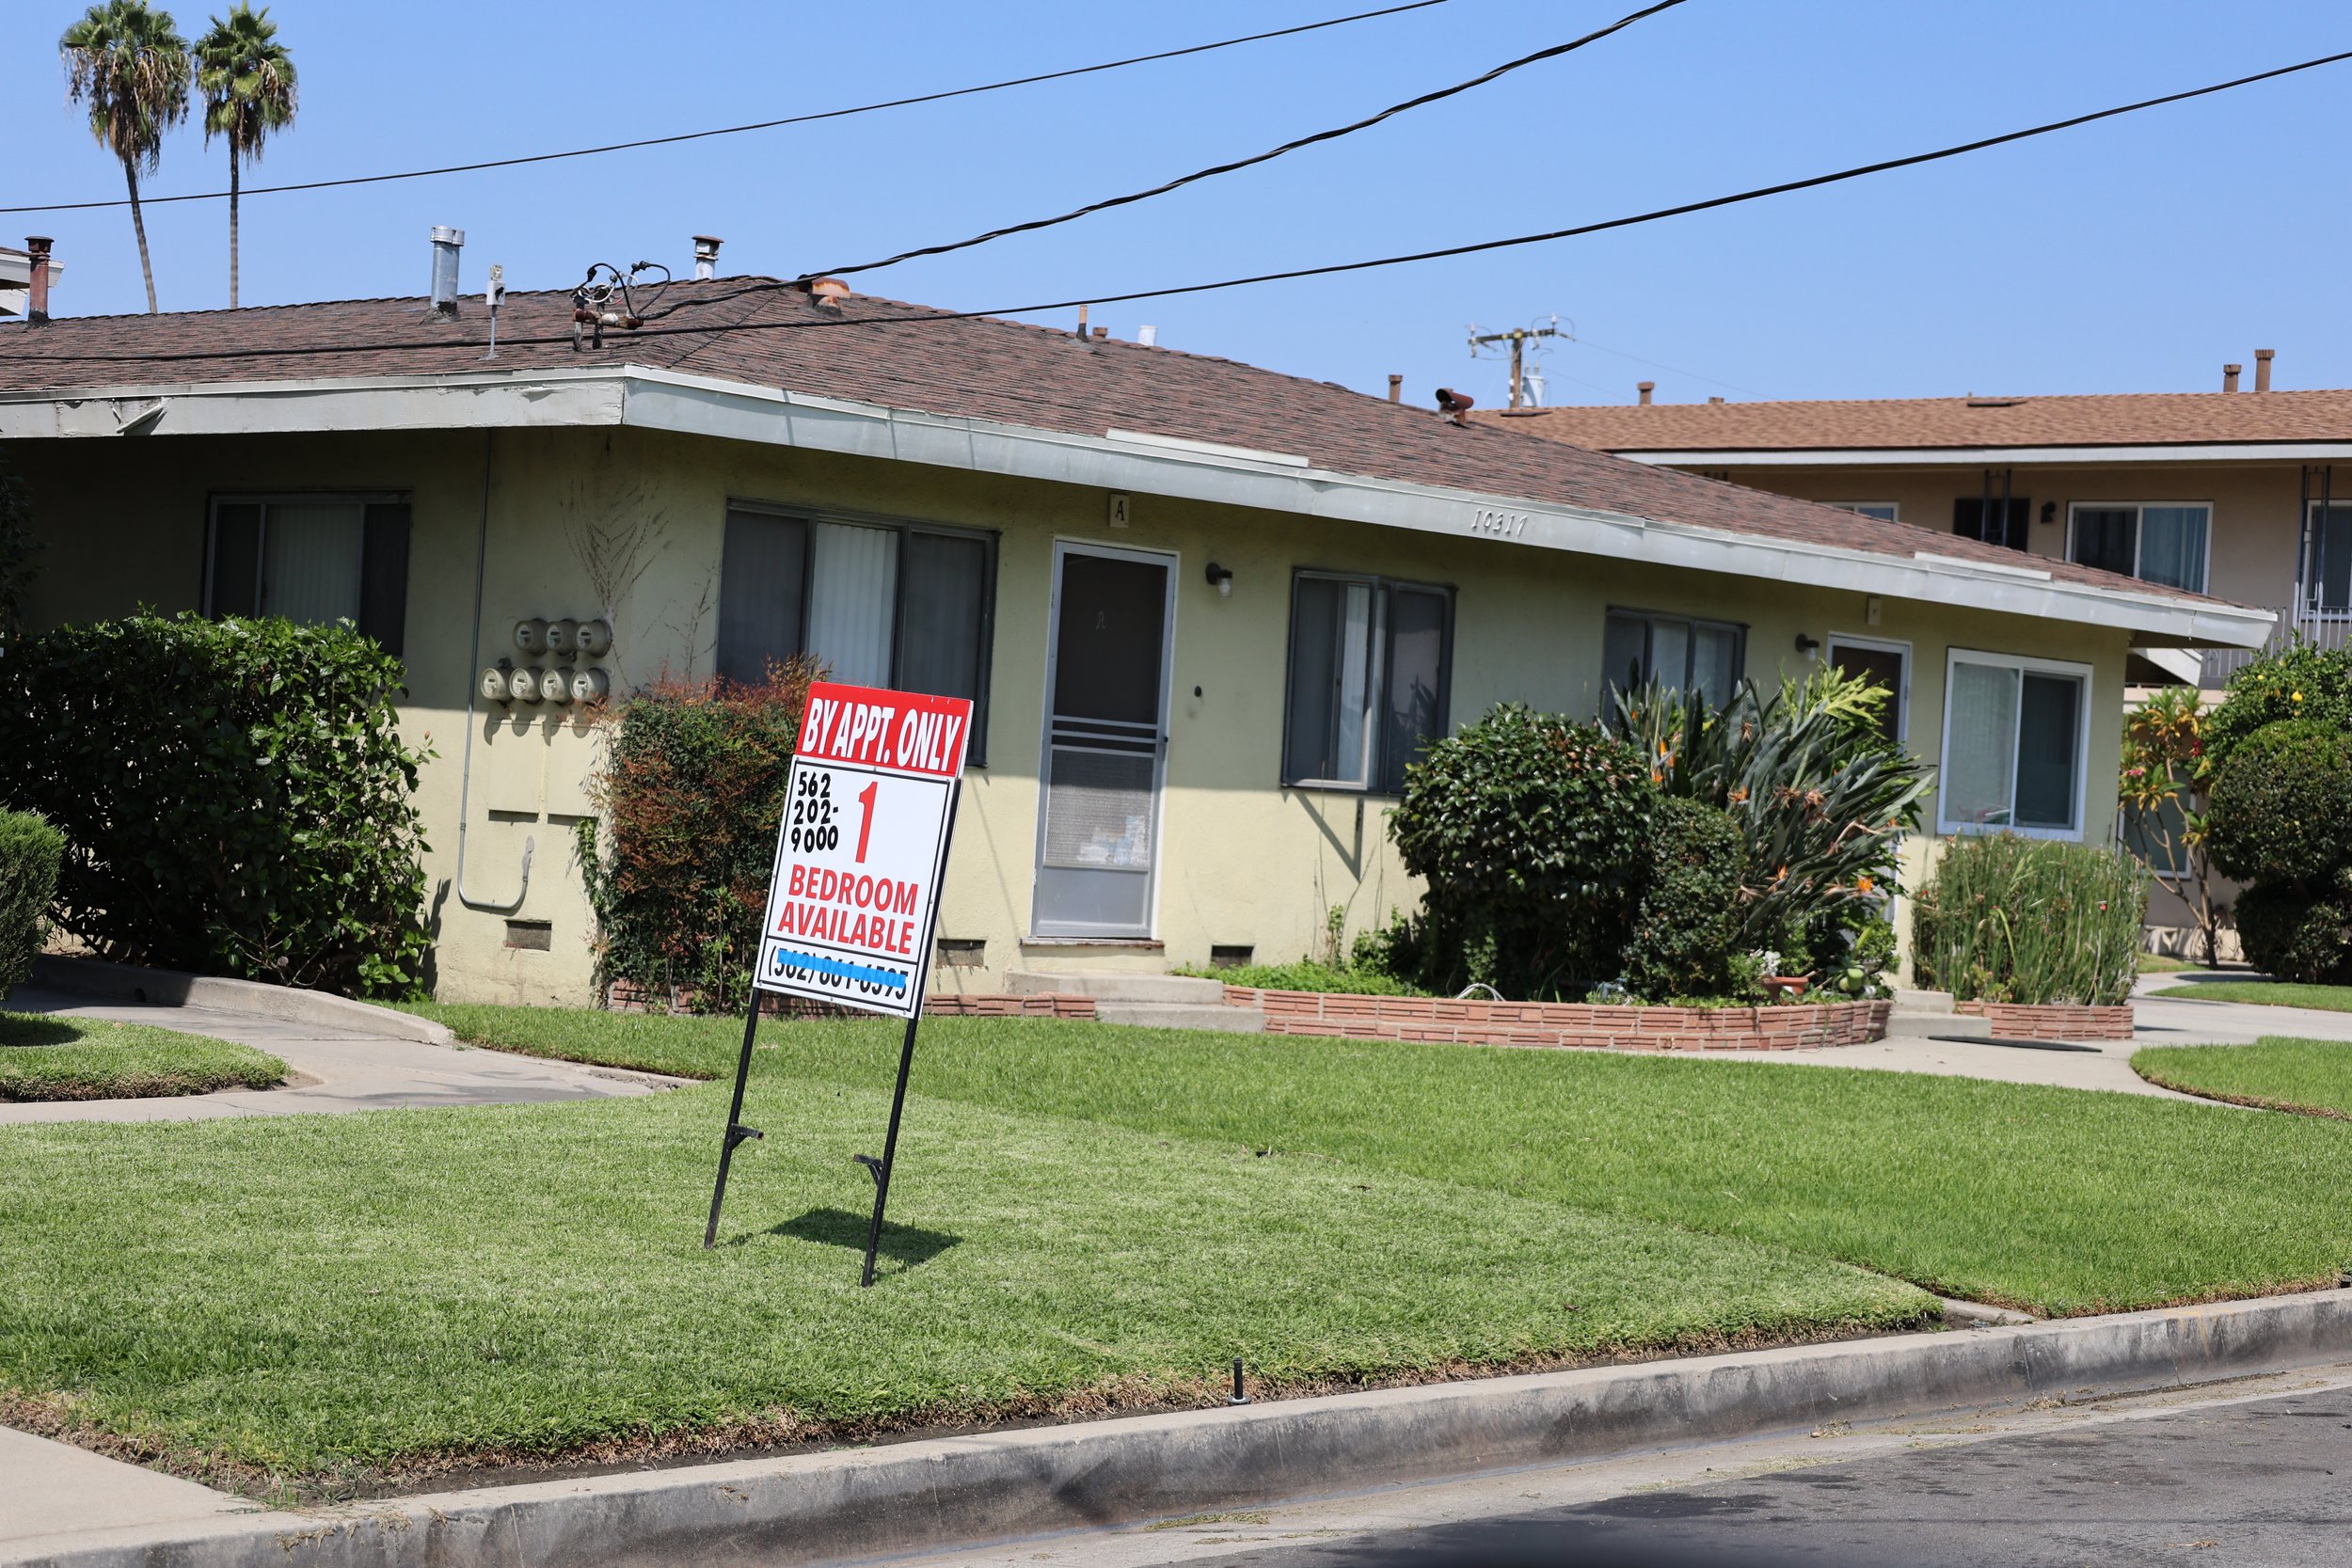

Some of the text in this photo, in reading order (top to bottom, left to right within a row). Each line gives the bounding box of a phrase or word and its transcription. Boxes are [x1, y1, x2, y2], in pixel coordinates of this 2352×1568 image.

[1115, 500, 1125, 521] A
[803, 698, 961, 771] BY APPT. ONLY
[798, 771, 831, 799] 562
[794, 799, 838, 825] 202-
[855, 781, 878, 863] 1
[791, 826, 838, 853] 9000
[788, 864, 918, 915] BEDROOM
[777, 901, 914, 955] AVAILABLE
